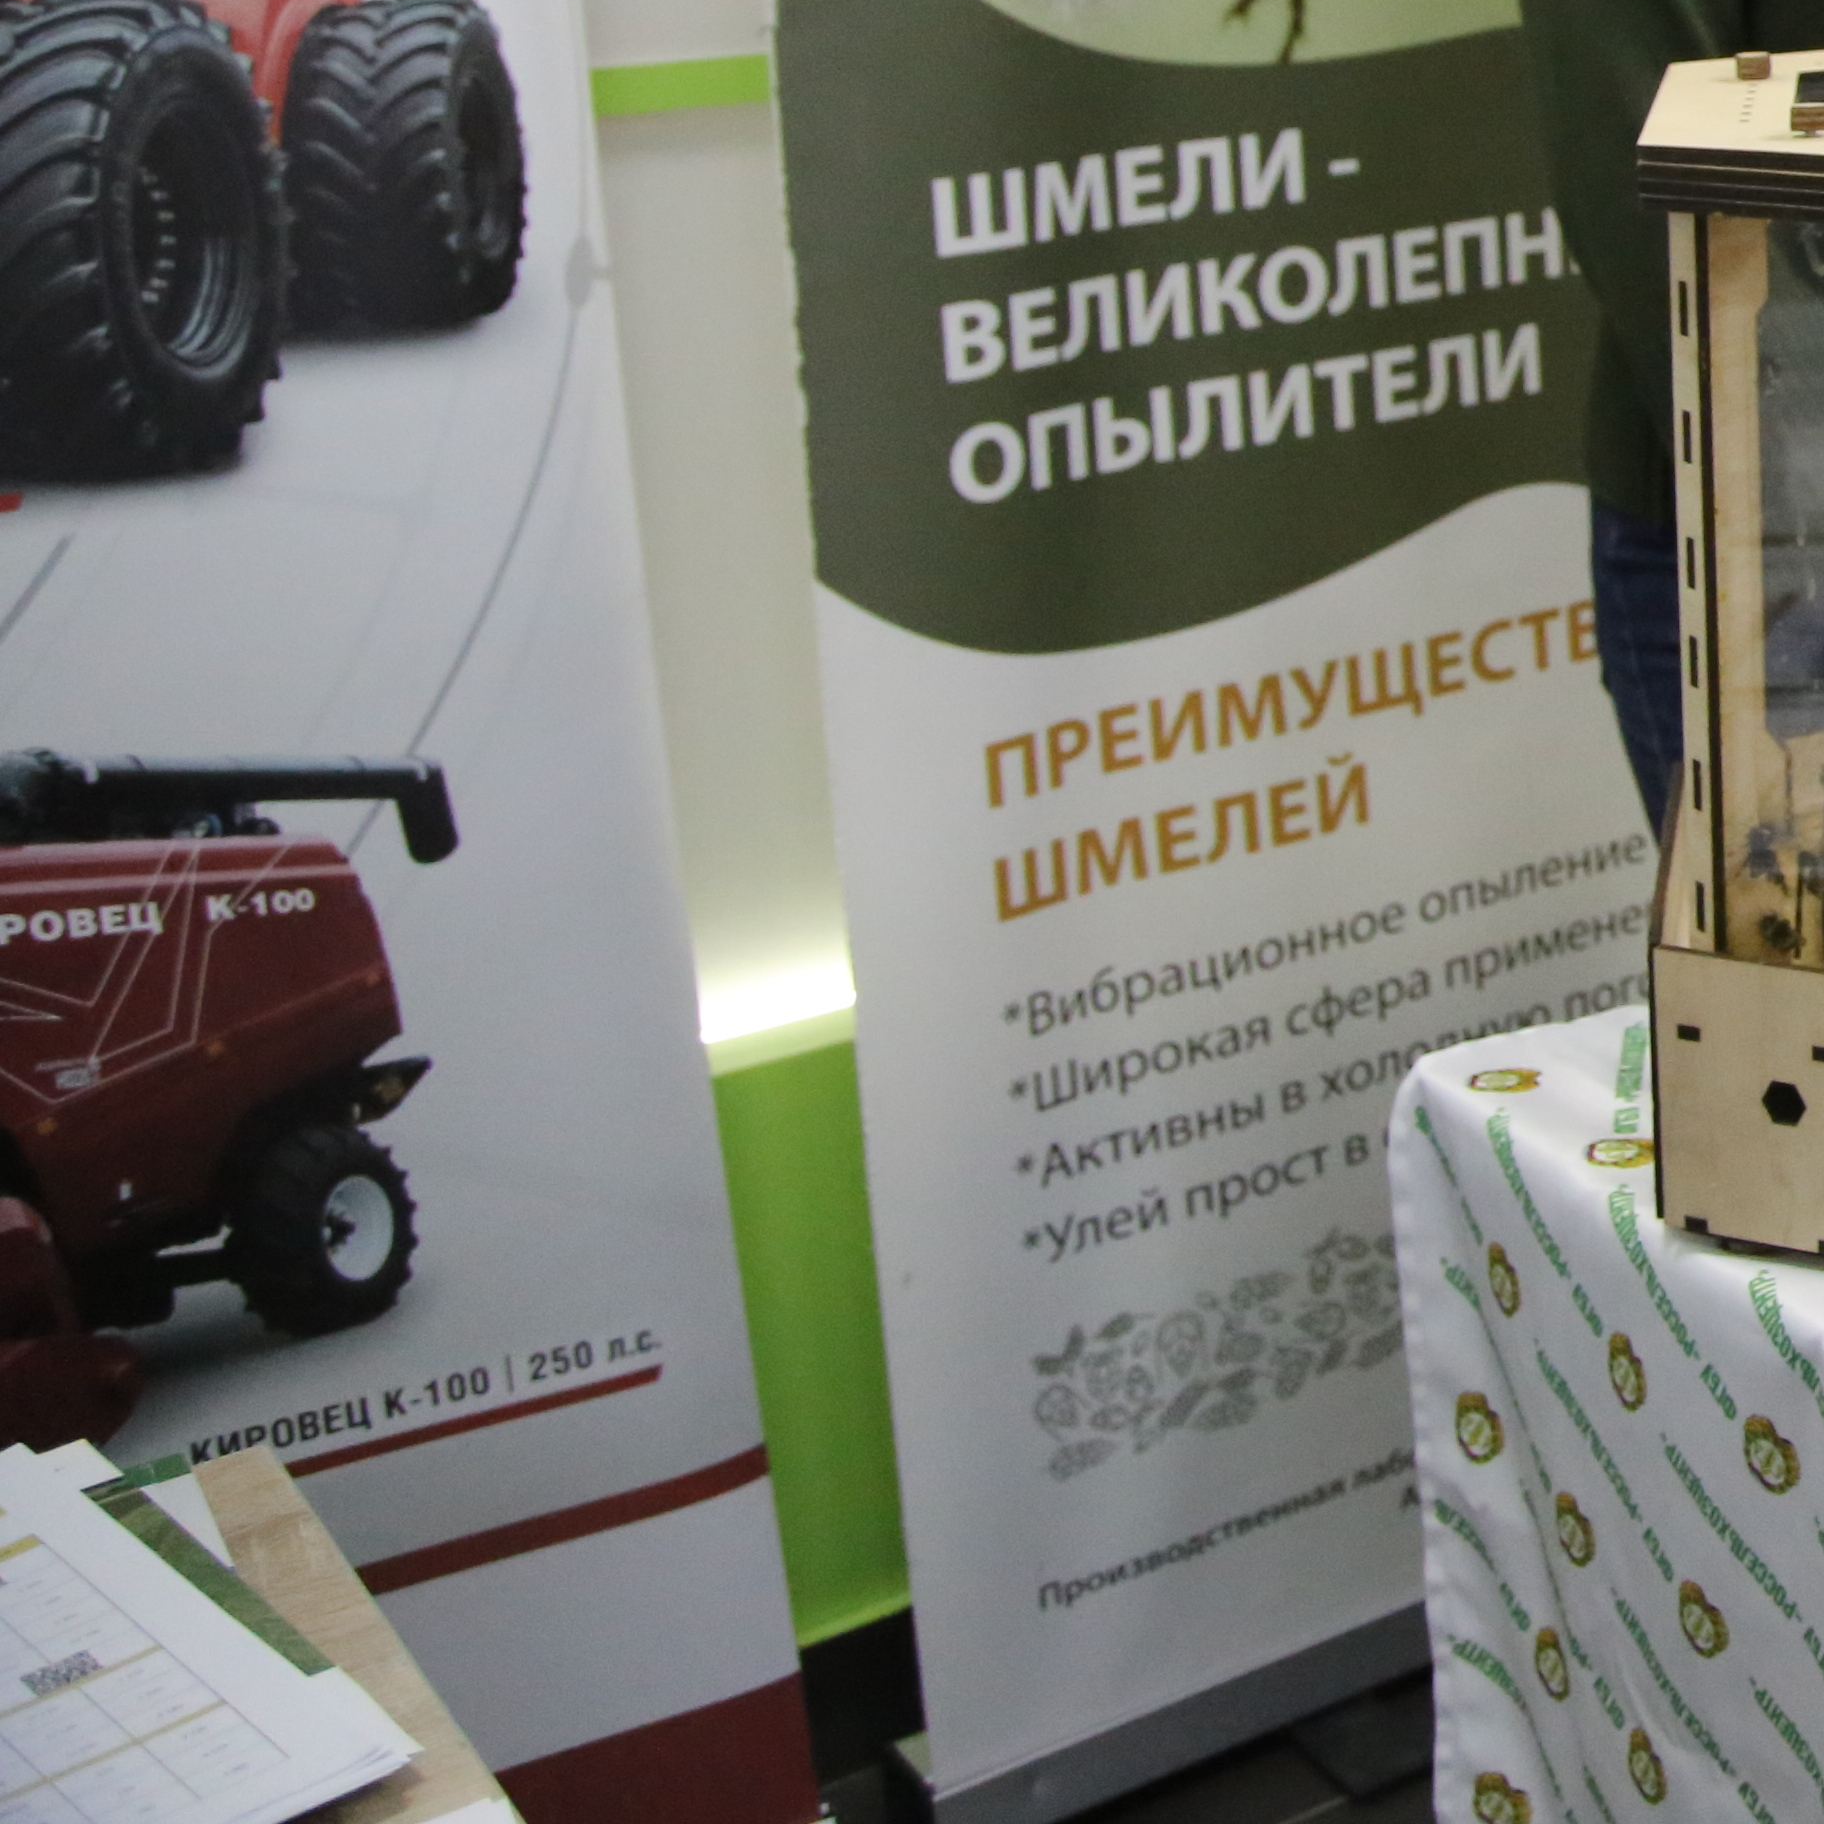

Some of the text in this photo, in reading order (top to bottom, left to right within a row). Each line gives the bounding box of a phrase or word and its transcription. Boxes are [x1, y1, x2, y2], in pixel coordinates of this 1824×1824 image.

[931, 127, 1361, 259] ШМЕЛИ -
[941, 206, 1582, 384] ВЕЛИКОЛЕПН
[948, 322, 1543, 505] ОПЫЛИТЕЛИ
[993, 750, 1371, 924] ШМЕЛЕЙ
[1418, 831, 1648, 923] опыление
[205, 887, 315, 923] К-100
[1286, 967, 1431, 1037] сфера
[1445, 901, 1651, 991] примене
[1280, 1079, 1306, 1114] в
[1184, 1144, 1329, 1219] прост
[1343, 1133, 1370, 1166] в
[383, 1366, 491, 1419] К-100
[527, 1340, 594, 1382] 250
[606, 1329, 662, 1364] л.с.
[1038, 1477, 1346, 1610] Производственная
